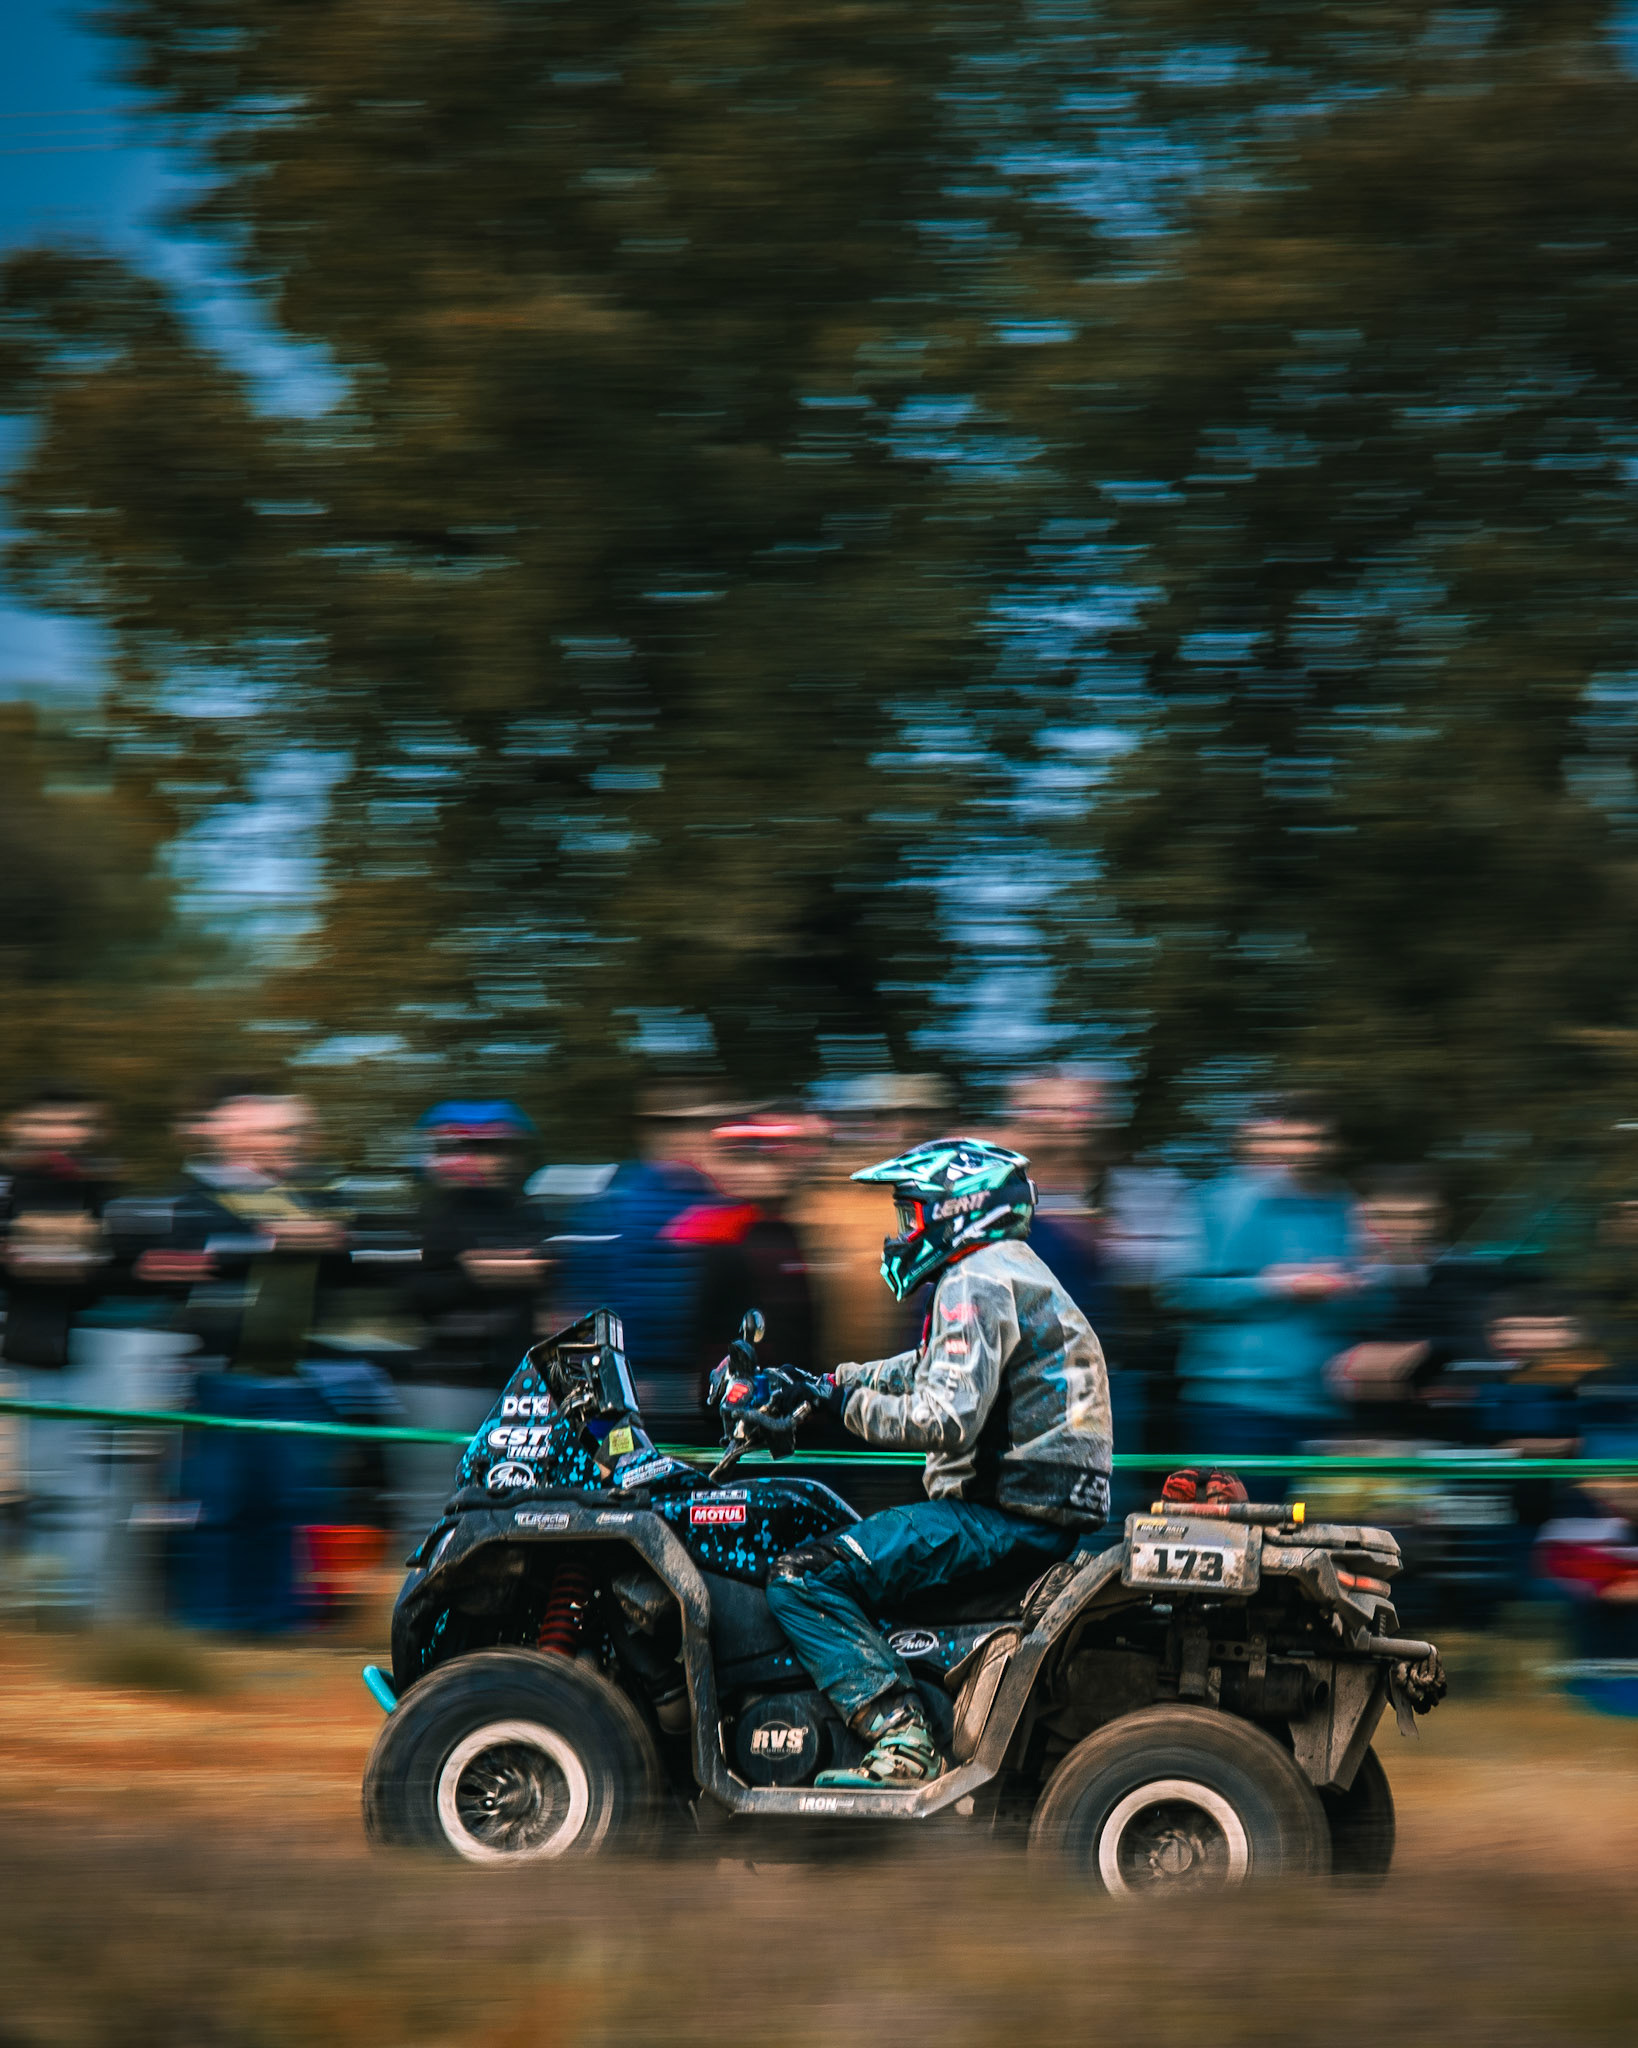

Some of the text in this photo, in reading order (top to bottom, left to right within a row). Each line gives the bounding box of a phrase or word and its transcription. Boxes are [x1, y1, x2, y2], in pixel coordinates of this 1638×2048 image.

[488, 1426, 552, 1449] CST
[508, 1445, 548, 1458] TIRES
[694, 1506, 742, 1521] MOTUL
[1154, 1548, 1224, 1581] 173
[799, 1797, 837, 1811] IRON
